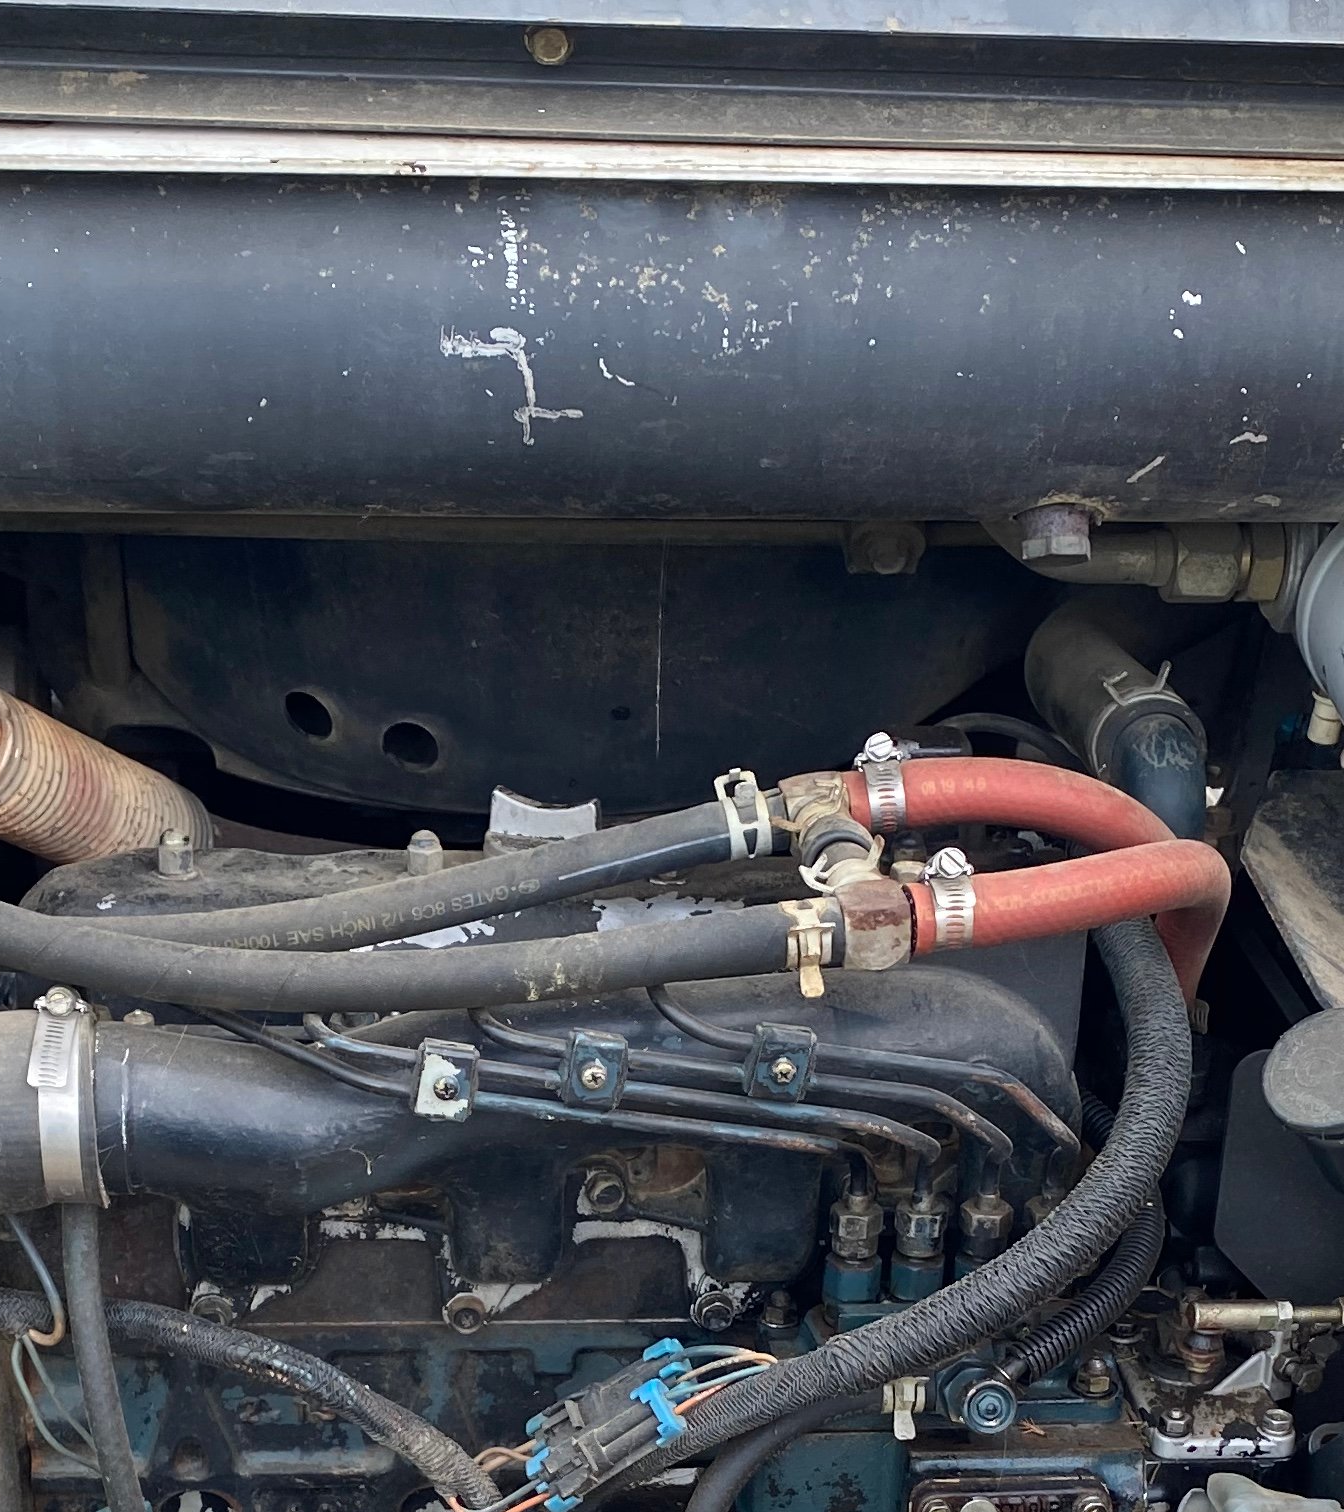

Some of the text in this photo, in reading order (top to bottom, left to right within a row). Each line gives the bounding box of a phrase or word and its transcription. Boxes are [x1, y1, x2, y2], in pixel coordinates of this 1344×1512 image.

[451, 883, 510, 913] GATES
[285, 924, 324, 946] SAE
[329, 913, 377, 937] INCH
